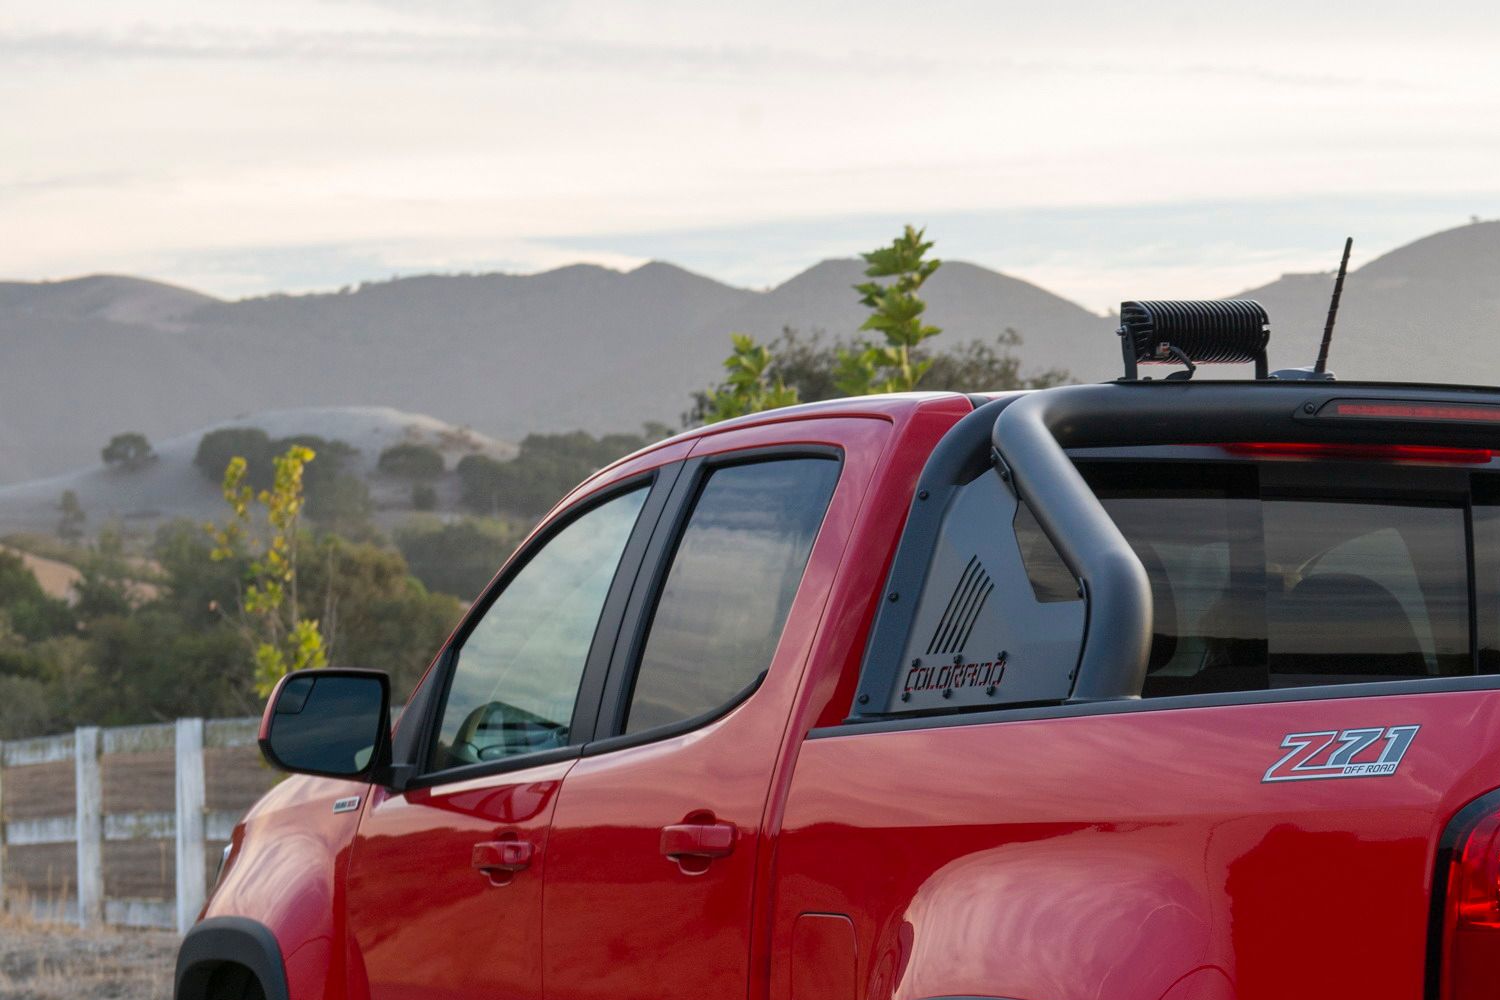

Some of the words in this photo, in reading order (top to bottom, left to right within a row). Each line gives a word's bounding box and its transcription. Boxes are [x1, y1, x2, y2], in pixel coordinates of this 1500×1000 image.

[904, 661, 1006, 692] COLORADO
[1261, 724, 1421, 783] Z71
[1344, 765, 1365, 775] OFF
[1365, 763, 1396, 773] ROAD
